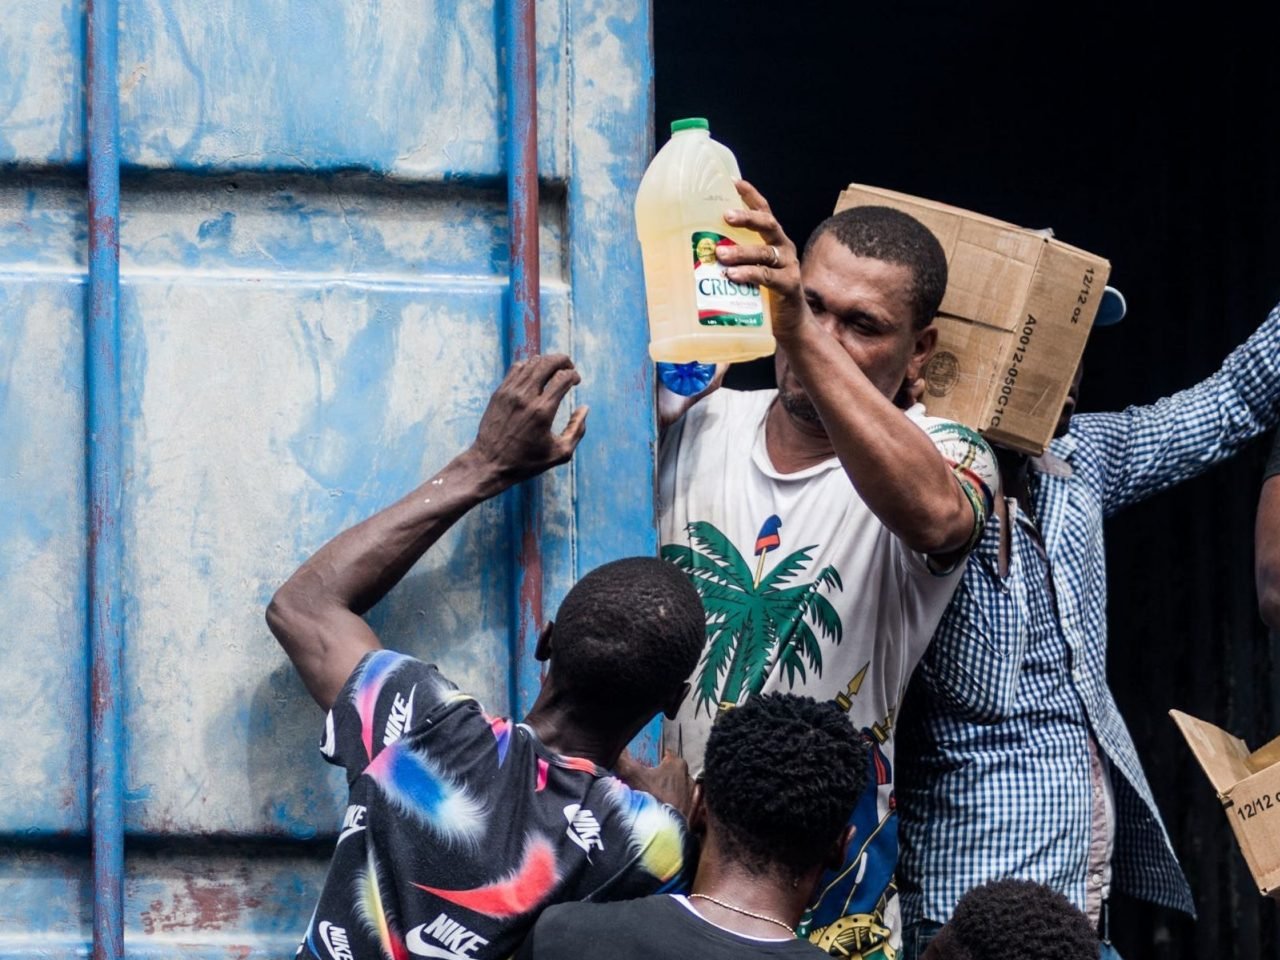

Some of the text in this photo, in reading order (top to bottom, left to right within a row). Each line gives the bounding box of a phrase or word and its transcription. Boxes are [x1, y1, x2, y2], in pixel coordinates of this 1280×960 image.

[1070, 267, 1095, 325] 12/12 oz
[990, 313, 1037, 428] A0012-050C1C
[383, 691, 410, 748] NIKE
[572, 809, 605, 851] NIKE
[1237, 794, 1274, 821] 12/12
[422, 912, 490, 960] NIKE
